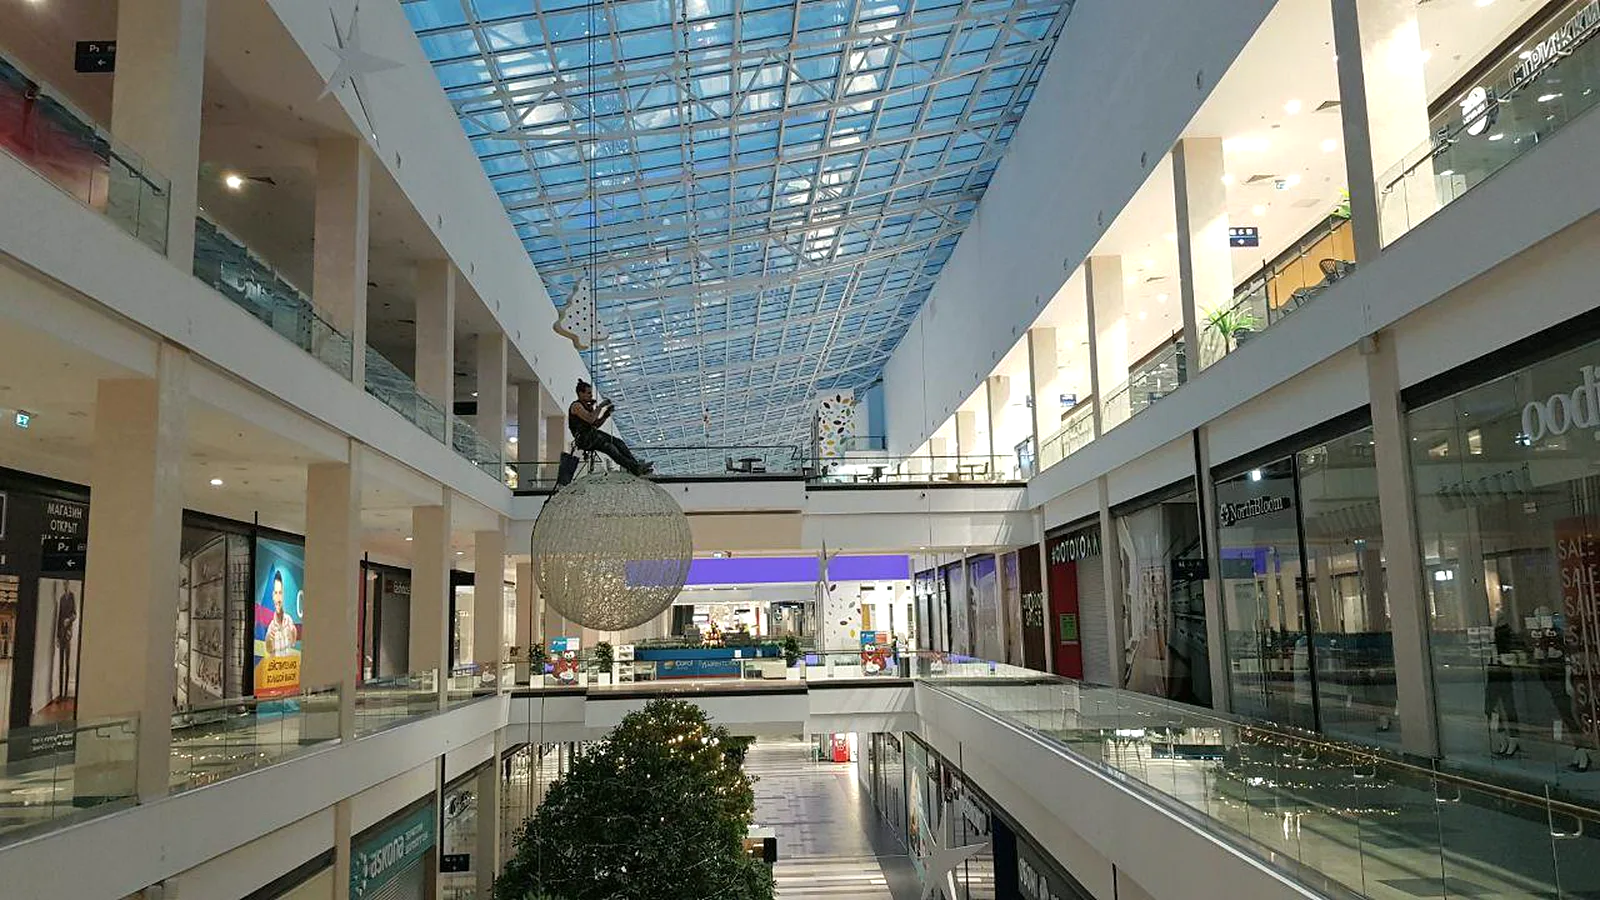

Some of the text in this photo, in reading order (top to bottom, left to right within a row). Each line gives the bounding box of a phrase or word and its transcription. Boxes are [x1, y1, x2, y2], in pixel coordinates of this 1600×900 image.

[47, 503, 83, 519] МАГАЗИН
[1229, 496, 1284, 521] NorthBloom
[50, 519, 79, 534] ОТКРЫТ
